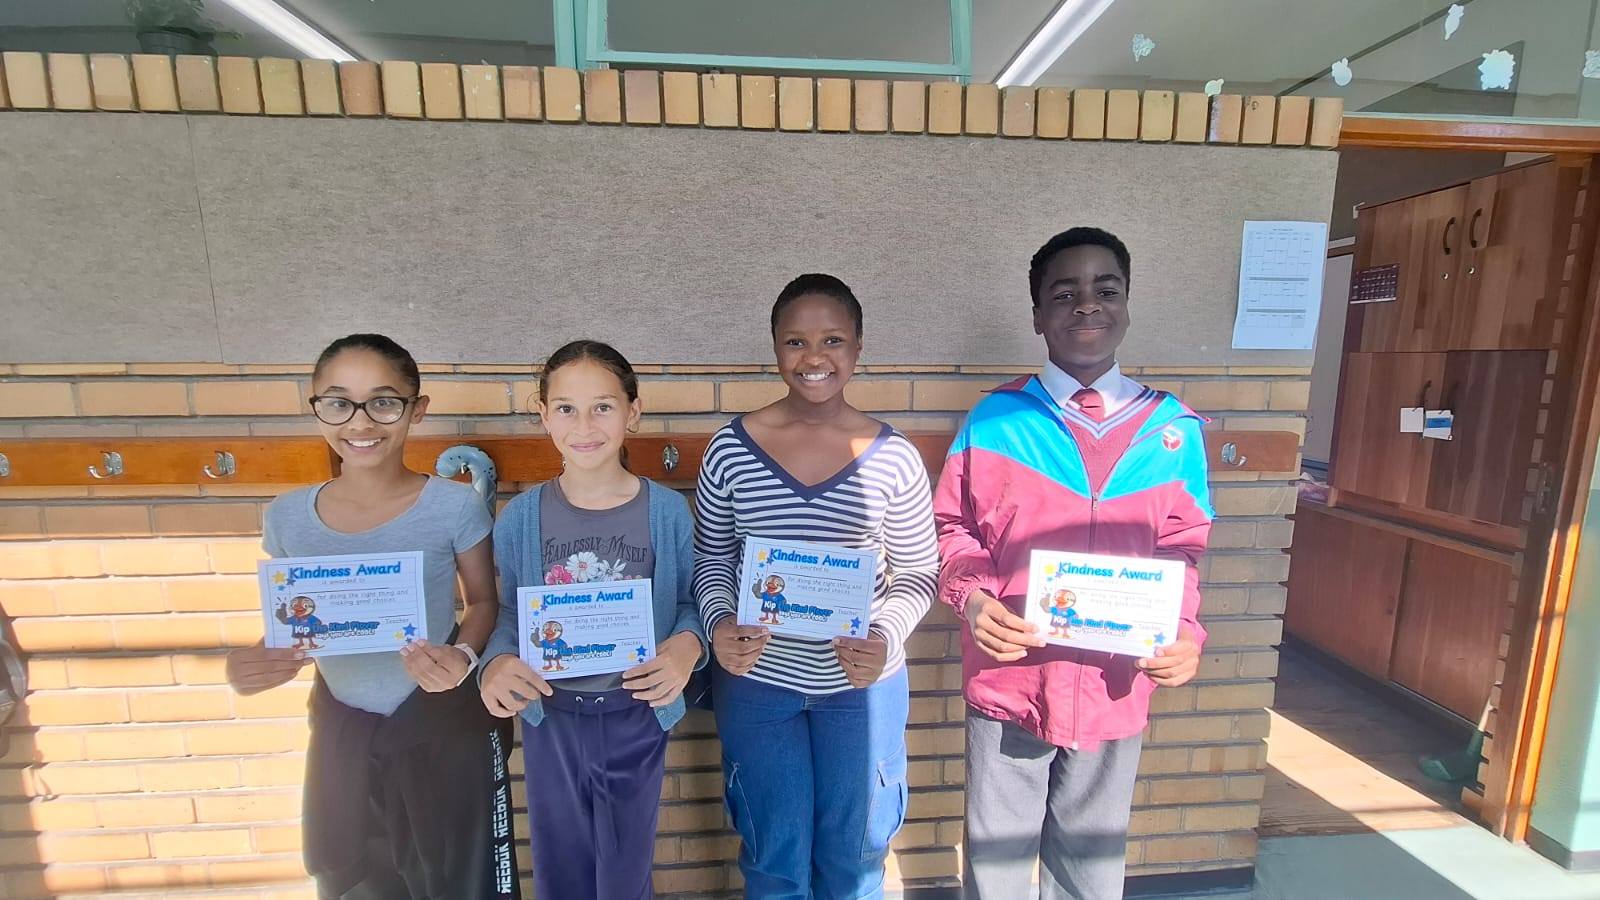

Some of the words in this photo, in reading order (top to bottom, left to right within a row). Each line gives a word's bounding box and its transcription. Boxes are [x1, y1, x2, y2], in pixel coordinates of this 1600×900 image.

[544, 537, 602, 564] FEARLESSLY
[608, 534, 648, 562] MYSELF
[769, 548, 818, 565] Kindness
[822, 555, 860, 569] Award
[288, 565, 351, 580] Kindness
[356, 561, 402, 577] Award
[1058, 561, 1114, 577] Kindness
[1118, 567, 1164, 582] Award
[543, 592, 592, 605] Kindness
[596, 588, 633, 601] Award
[764, 600, 777, 611] Kip
[295, 625, 309, 635] Kip
[1053, 616, 1067, 627] Kip
[545, 648, 558, 659] Kip
